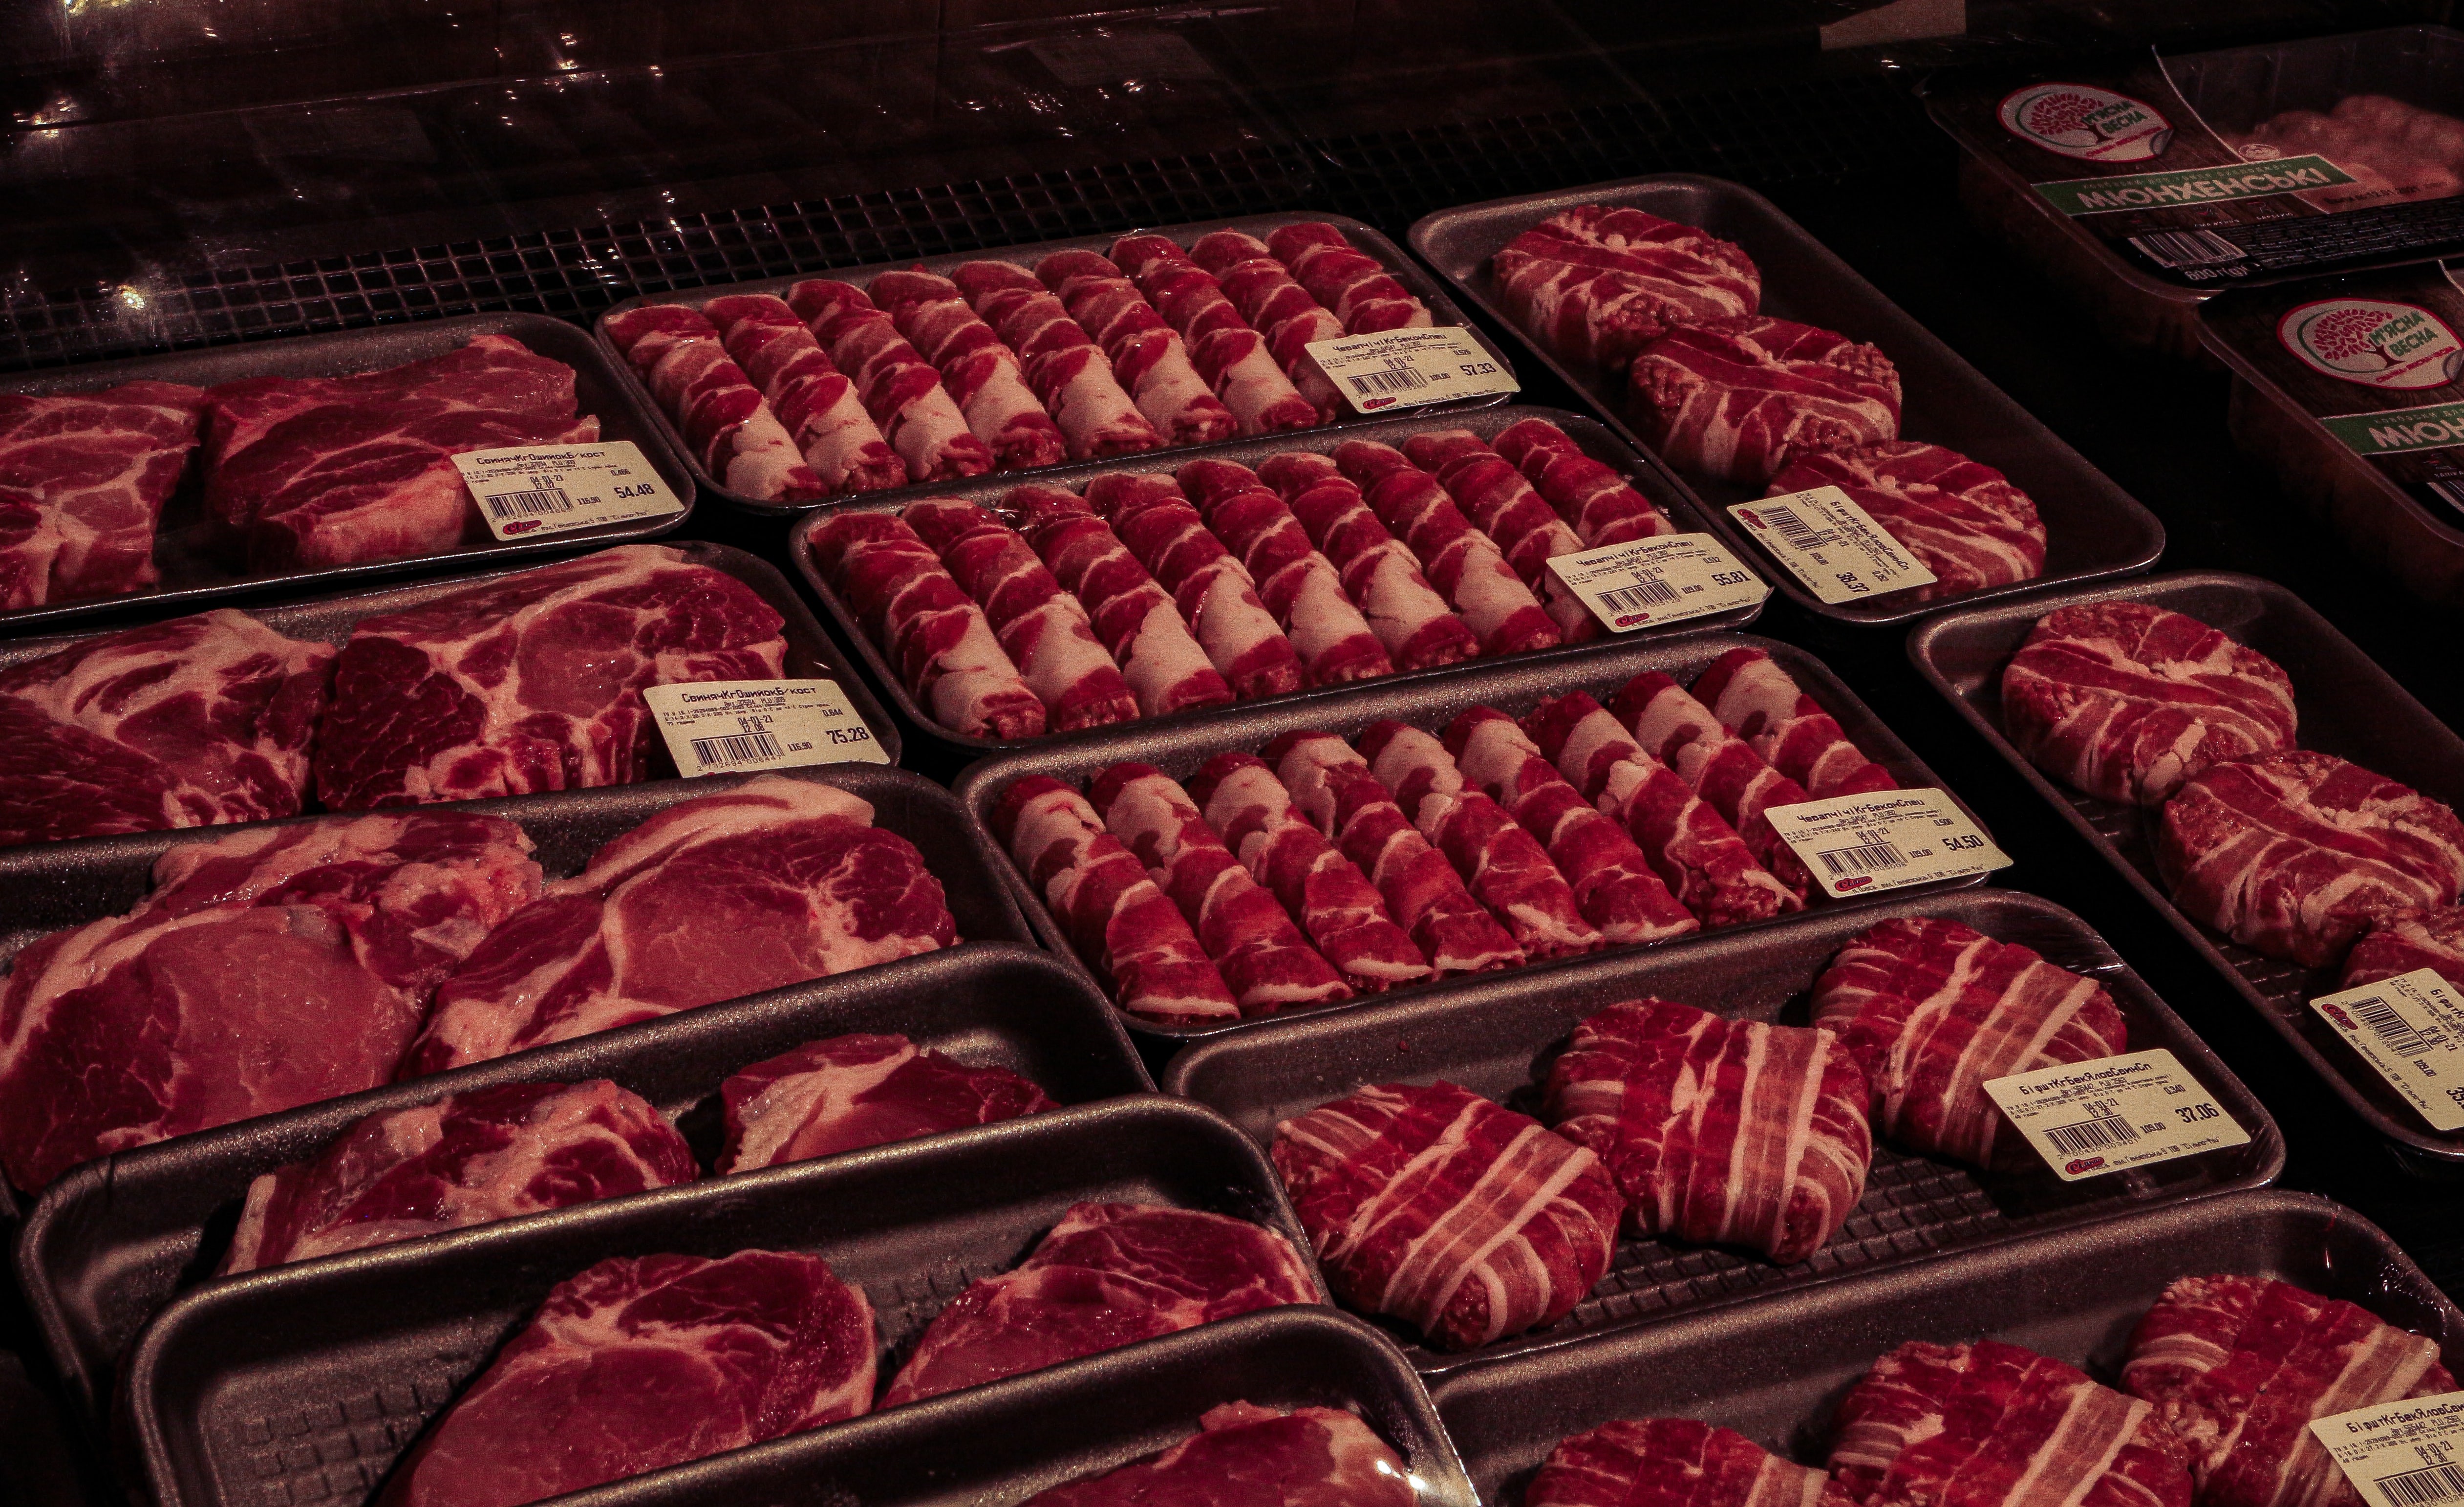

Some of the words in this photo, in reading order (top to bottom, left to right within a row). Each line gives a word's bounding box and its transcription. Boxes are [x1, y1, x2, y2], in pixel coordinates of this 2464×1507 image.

[2102, 110, 2147, 133] ВЕСНА
[2077, 167, 2330, 209] МЮНХЕНСЬКІ
[2369, 311, 2426, 345] М'ЯСНА
[2389, 326, 2439, 357] ВЕСНА
[1459, 363, 1497, 376] 57.33
[529, 474, 565, 484] 04-01-21
[613, 483, 656, 499] 54.48
[1630, 566, 1664, 578] 04-01-21
[1711, 570, 1752, 586] 55.81
[1835, 571, 1871, 594] 38.37
[681, 687, 816, 703] СвинячКгОшийокБ/кост
[737, 714, 774, 726] 04-01-21
[822, 708, 844, 717] 0.644
[786, 741, 813, 752] 116.90
[825, 726, 870, 745] 75.28
[1932, 818, 1954, 827] 0.500
[1855, 827, 1891, 839] 04-01-21
[1908, 848, 1933, 859] 109.00
[1941, 834, 1985, 851] 54.50
[2425, 1026, 2459, 1052] 04-01-21
[2412, 1059, 2437, 1077] 109.00
[2163, 1084, 2186, 1095] 0.340
[2082, 1098, 2120, 1112] 04-01-21
[2140, 1121, 2166, 1134] 109.00
[2174, 1103, 2220, 1123] 37.06
[2414, 1440, 2454, 1457] 04-01-21
